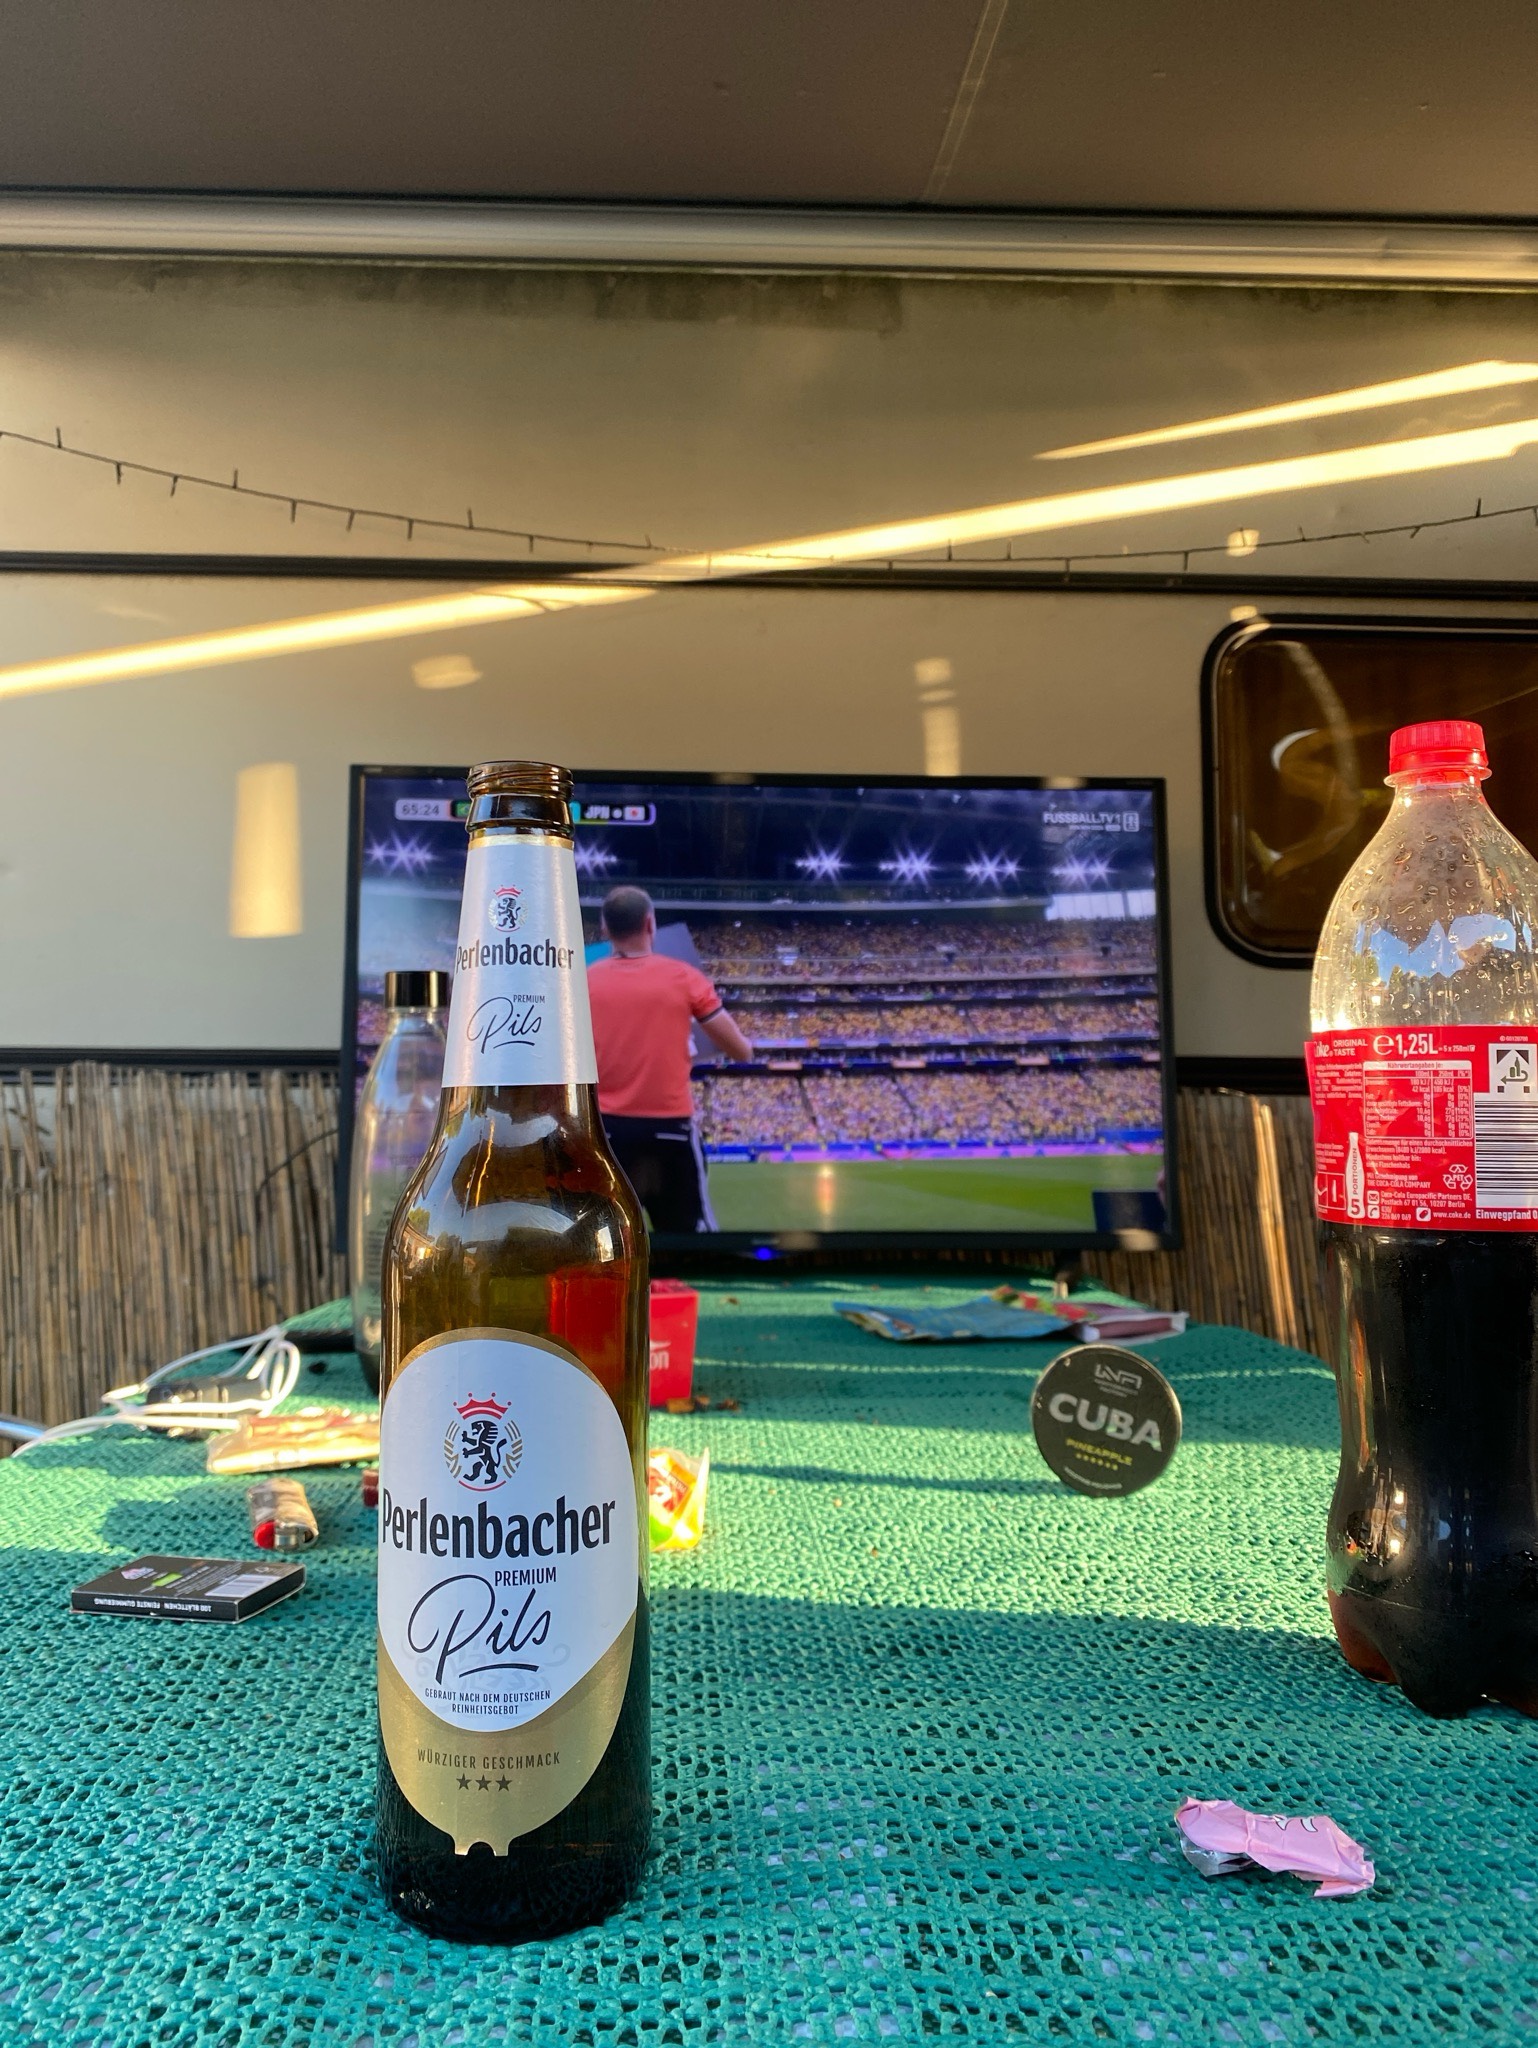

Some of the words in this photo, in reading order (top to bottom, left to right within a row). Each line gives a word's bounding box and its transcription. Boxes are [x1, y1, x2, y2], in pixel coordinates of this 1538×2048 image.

[402, 803, 440, 817] 65:24
[584, 804, 611, 819] JPN
[455, 936, 575, 974] Perlenbacher
[513, 994, 546, 1004] PREMIUM
[466, 996, 542, 1054] Pils
[1333, 1038, 1368, 1048] ORIGINAL
[1395, 1033, 1438, 1058] 1,25L
[1333, 1048, 1356, 1057] TASTE
[1351, 1198, 1360, 1215] 5
[1447, 1200, 1466, 1208] Berlin
[1432, 1211, 1472, 1219] www.coke.de
[1475, 1209, 1532, 1221] Einwegpfand
[1048, 1393, 1163, 1452] CUBA
[1065, 1438, 1133, 1466] PINEAPPLE
[382, 1487, 616, 1560] Perlenbacher
[495, 1567, 557, 1587] PREMIUM
[407, 1574, 551, 1685] Pils
[425, 1687, 456, 1701] GEBRAUT
[459, 1692, 484, 1703] NACH
[484, 1693, 500, 1703] DEM
[503, 1689, 551, 1703] DEUTSCHEN
[452, 1704, 519, 1715] REINHEITSGEBOT
[417, 1748, 477, 1769] WÜRZIGER
[483, 1751, 561, 1770] GESCHMACK
